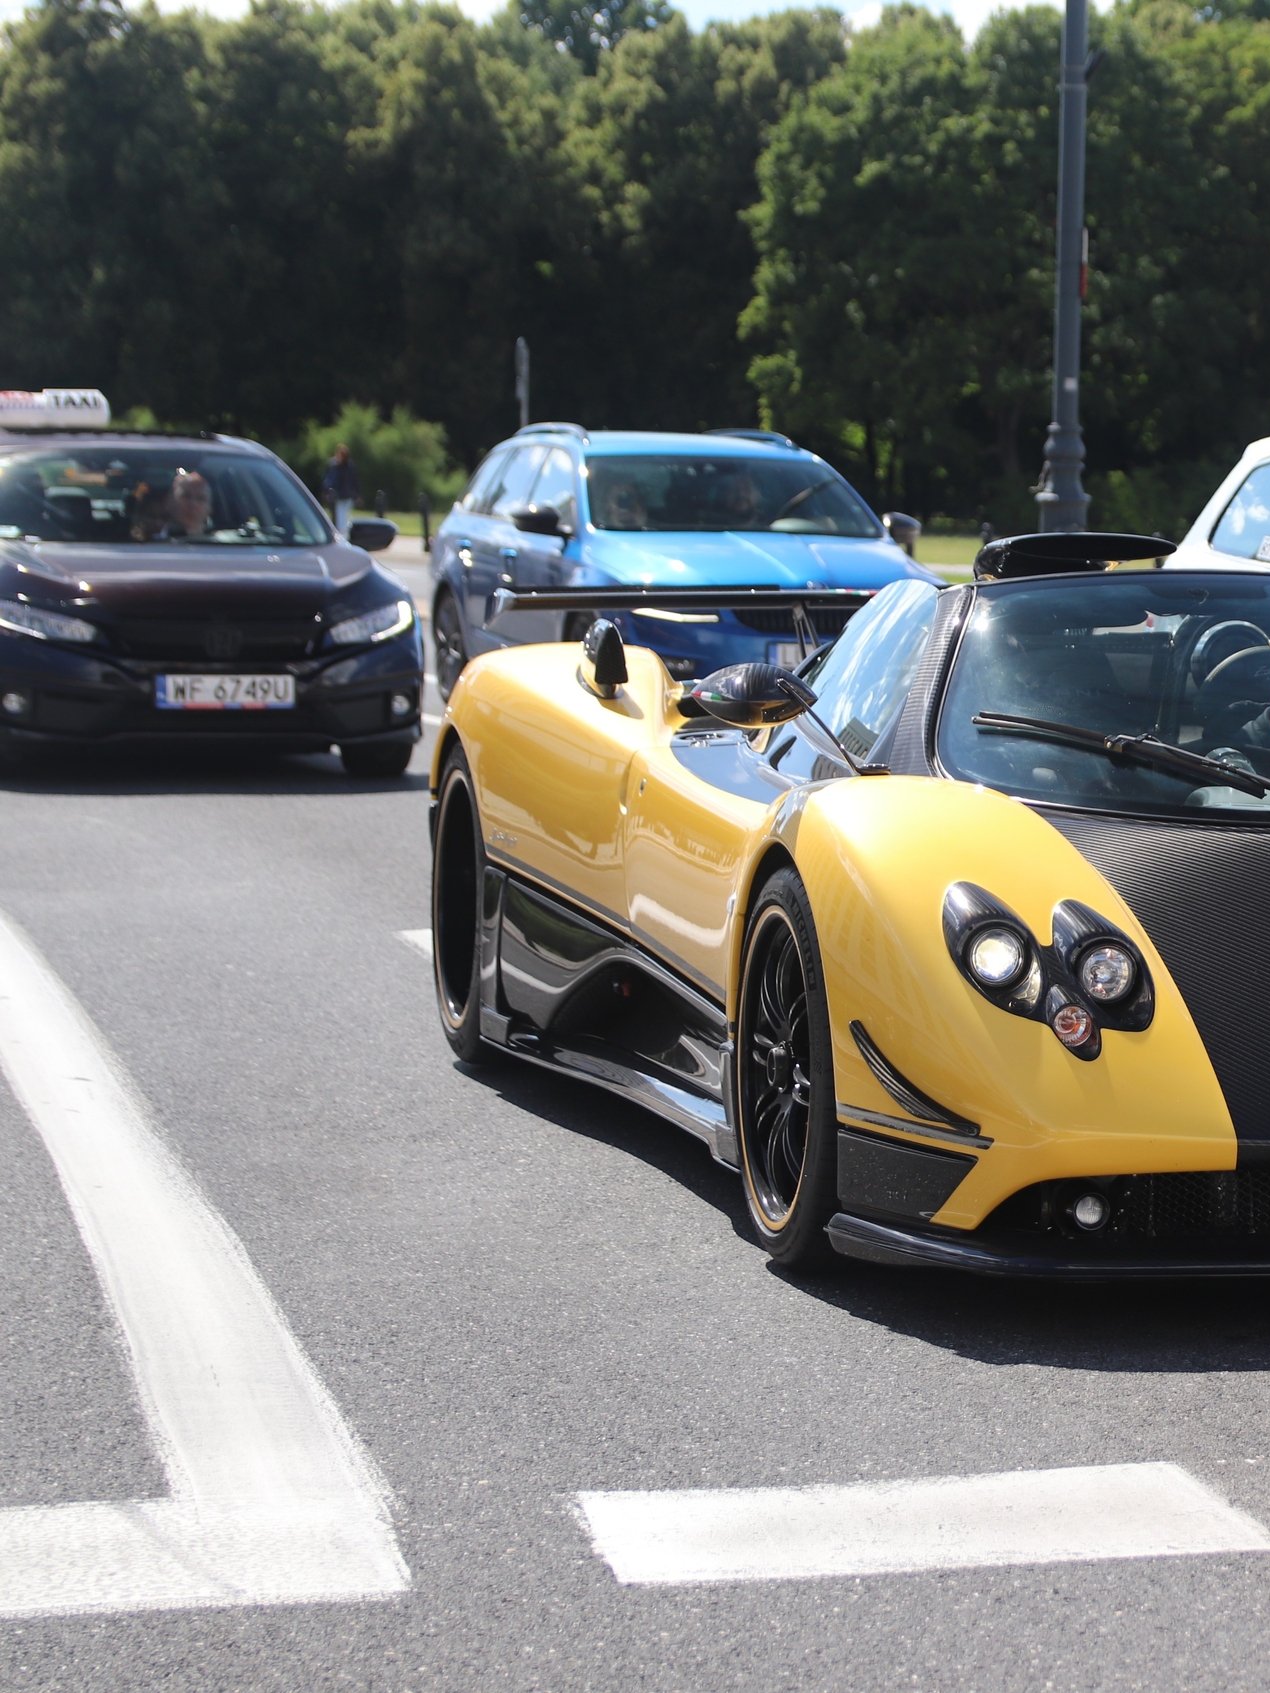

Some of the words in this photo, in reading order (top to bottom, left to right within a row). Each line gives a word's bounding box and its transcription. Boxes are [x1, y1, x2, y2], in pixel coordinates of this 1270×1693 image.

[50, 394, 100, 408] TAXI
[172, 678, 203, 701] WF
[213, 678, 290, 701] 6749U
[790, 901, 816, 985] MICHELIN
